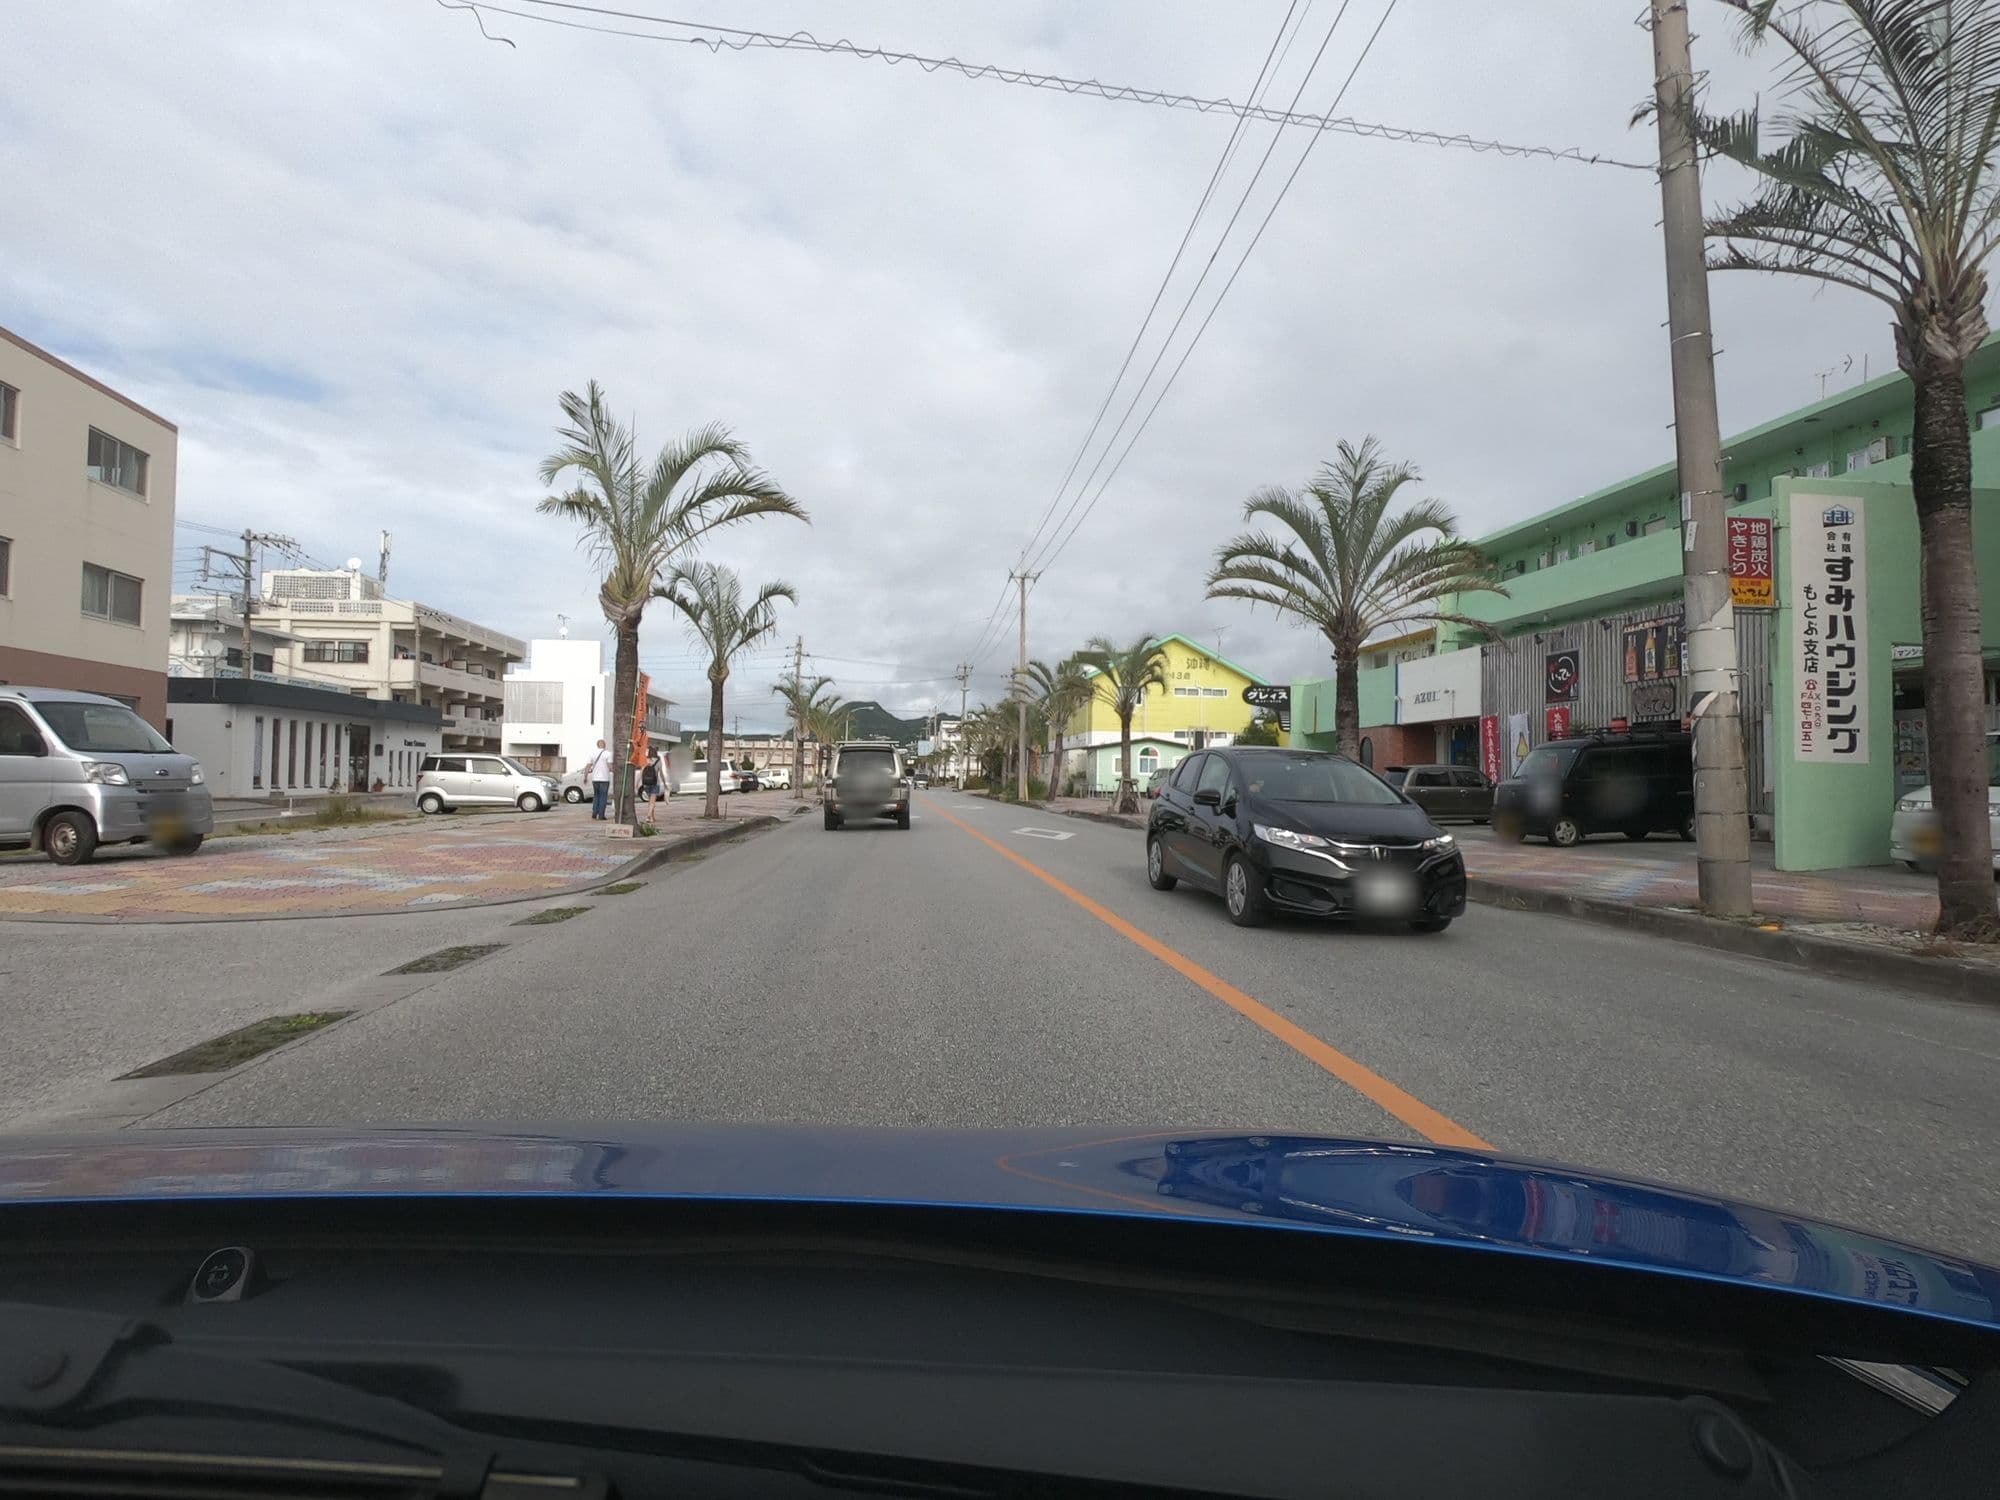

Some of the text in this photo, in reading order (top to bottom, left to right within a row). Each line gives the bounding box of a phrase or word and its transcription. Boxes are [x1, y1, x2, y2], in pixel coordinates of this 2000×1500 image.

[1730, 520, 1748, 575] やきとり
[1750, 521, 1768, 577] 地鶏炭火
[1826, 531, 1836, 552] 会社
[1803, 584, 1819, 674] もとぶ支店
[1823, 556, 1860, 754] すみハウジング
[1801, 691, 1821, 700] FAX
